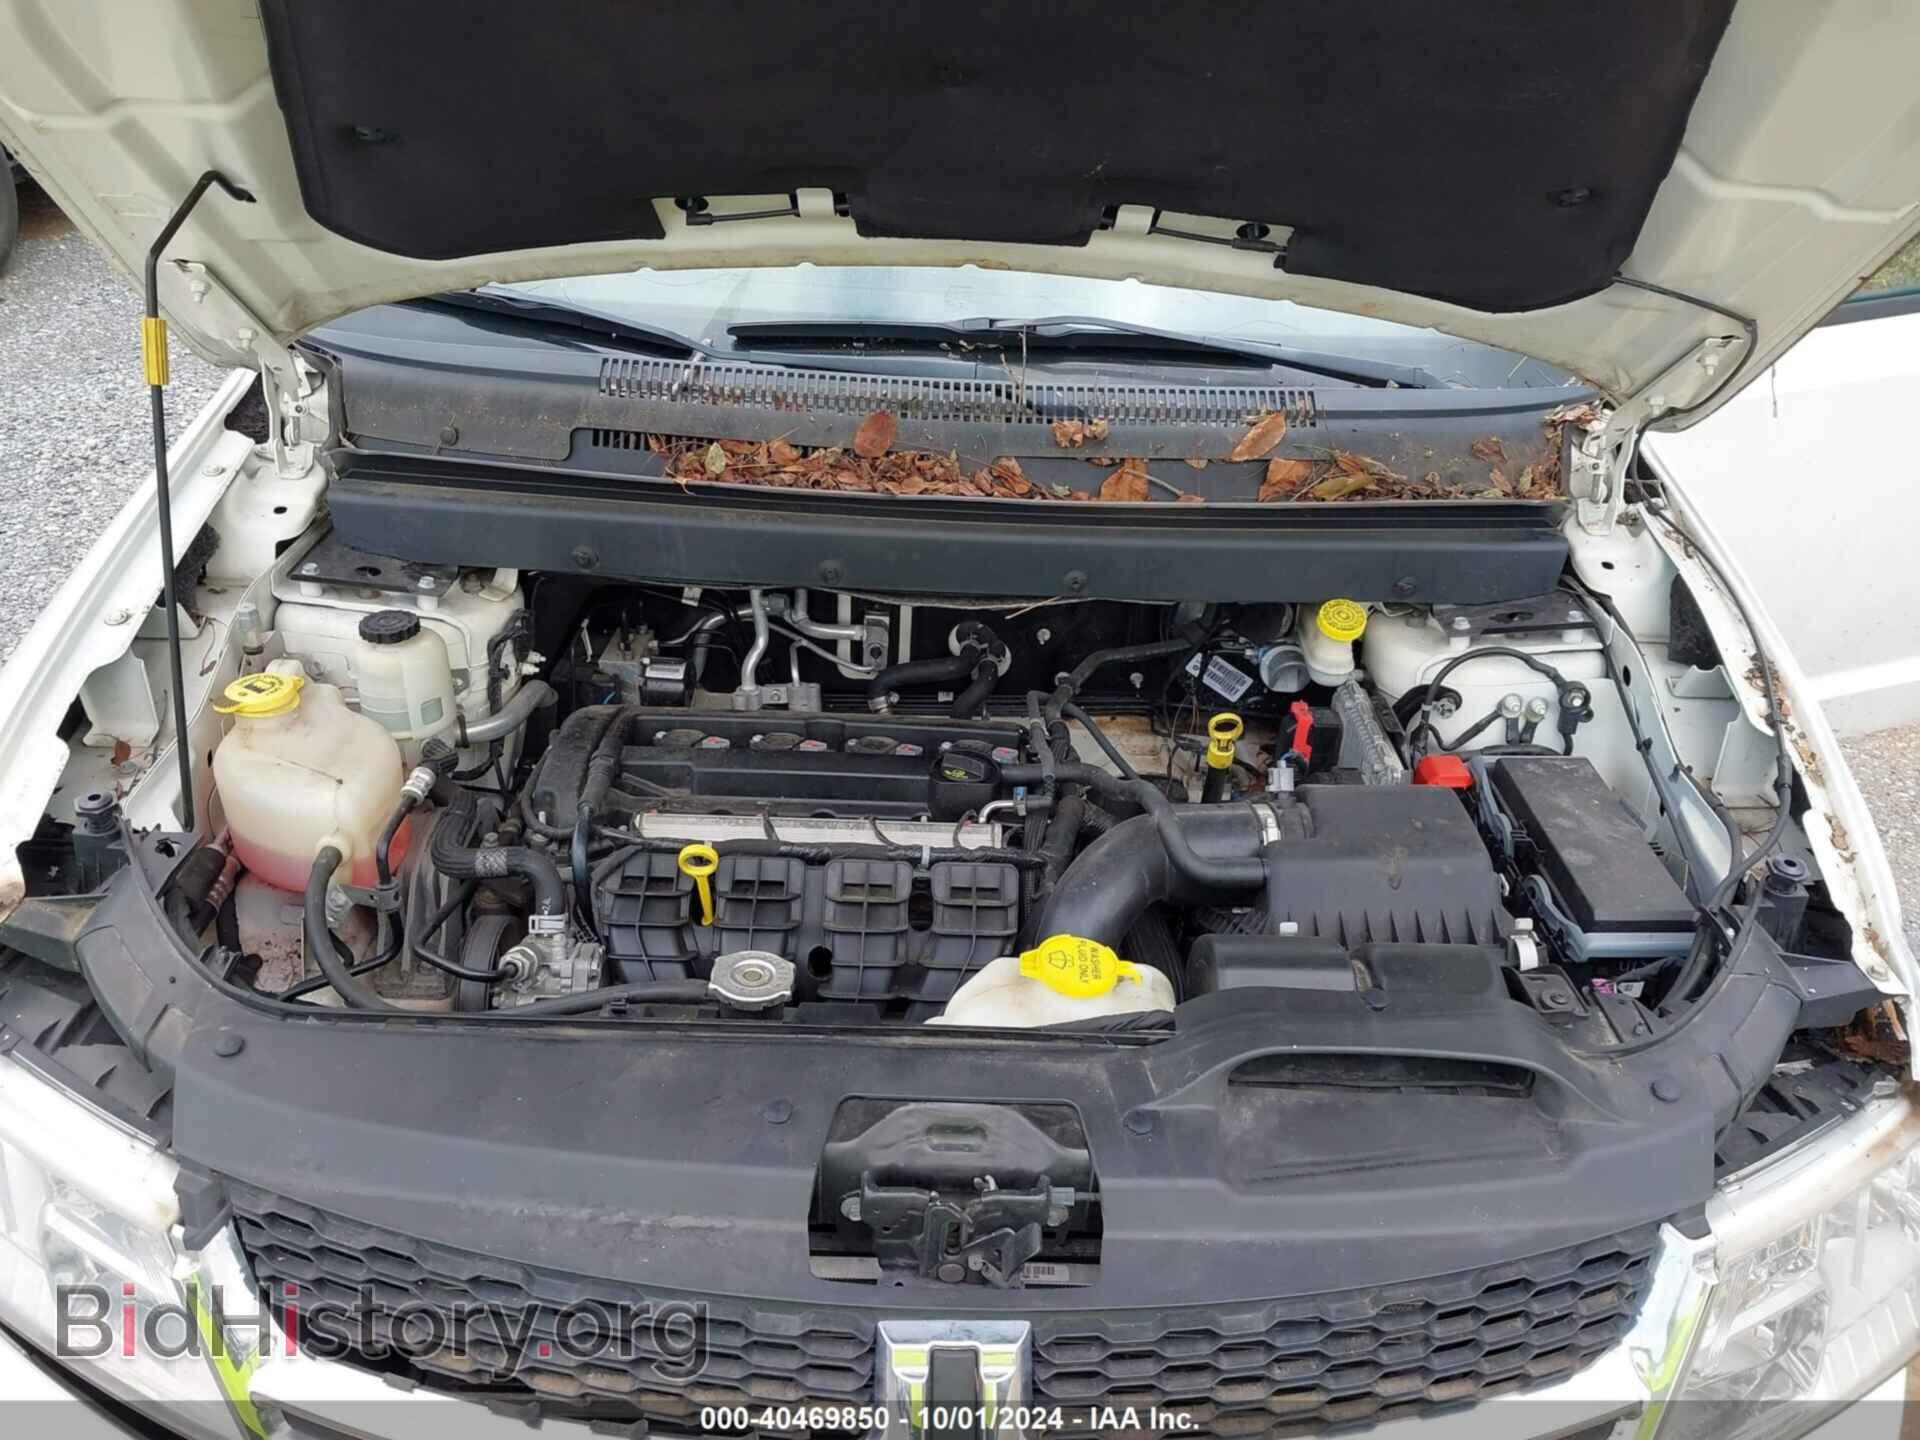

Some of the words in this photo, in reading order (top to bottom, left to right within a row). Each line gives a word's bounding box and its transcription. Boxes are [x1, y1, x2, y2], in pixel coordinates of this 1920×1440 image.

[1078, 940, 1088, 962] FLUID
[1079, 964, 1090, 984] ONLY
[1090, 947, 1102, 980] WASHER
